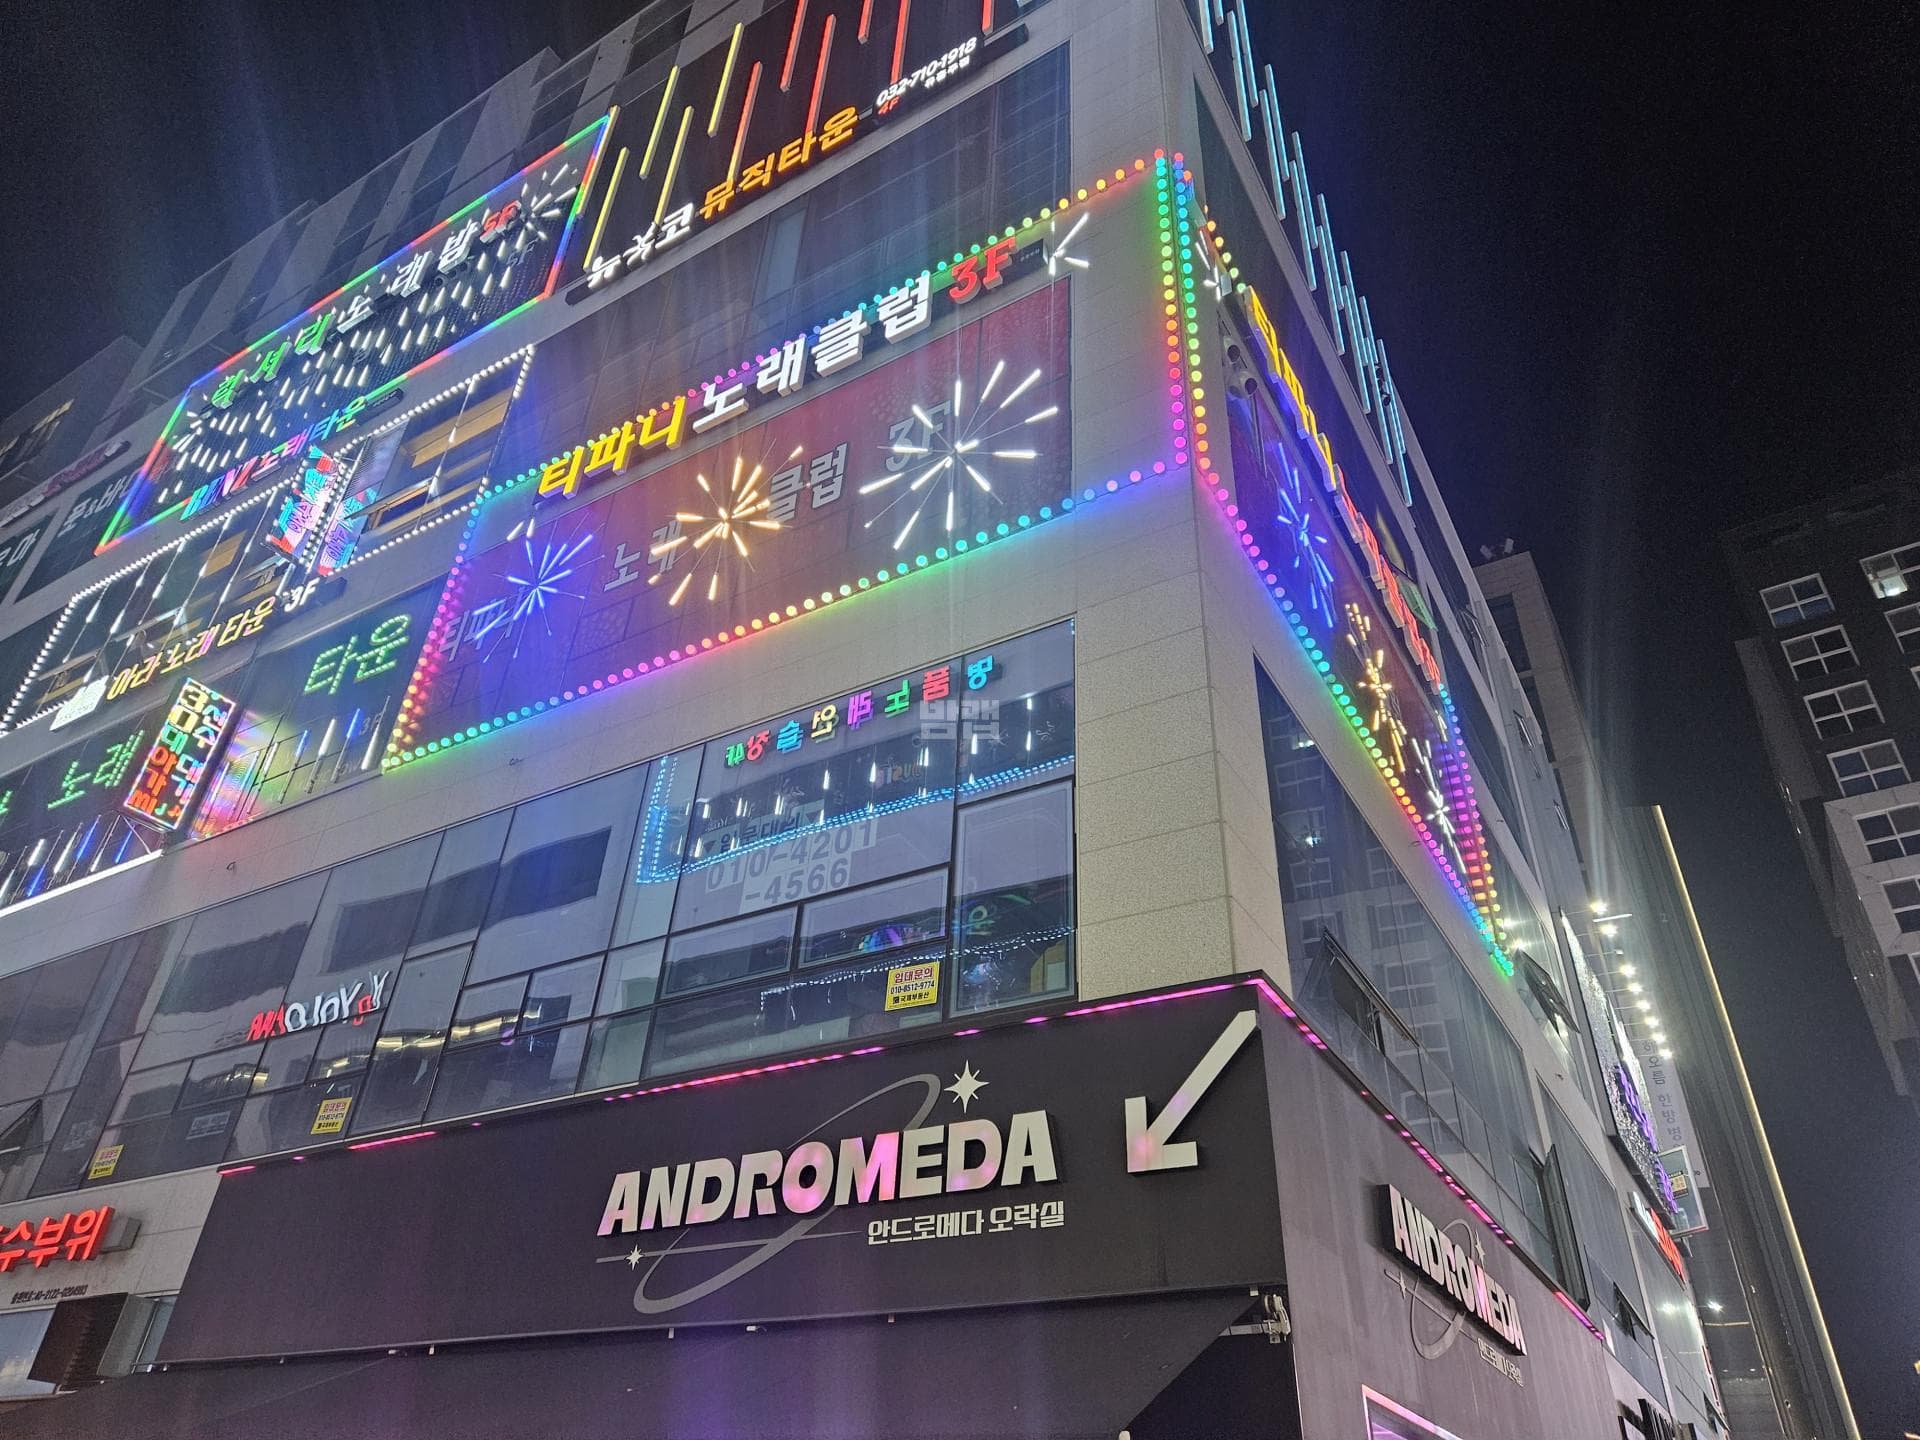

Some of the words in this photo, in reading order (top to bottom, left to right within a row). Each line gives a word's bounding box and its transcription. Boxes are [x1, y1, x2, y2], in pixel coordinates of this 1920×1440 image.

[876, 37, 977, 107] 032-710-1918
[699, 105, 859, 220] 뮤직타운
[537, 396, 687, 498] 티파니
[690, 270, 931, 436] 노래클럽
[949, 238, 1017, 302] 3F
[886, 400, 951, 472] 3F
[47, 729, 144, 811] 노래
[303, 613, 410, 695] 타운
[893, 966, 934, 984] 임대문의
[596, 1110, 1058, 1238] ANDROMEDA
[0, 1205, 114, 1273] 수부위
[867, 1210, 985, 1246] 안드로메다
[988, 1200, 1066, 1234] 오락실
[1388, 1184, 1528, 1356] ANDROMEDA
